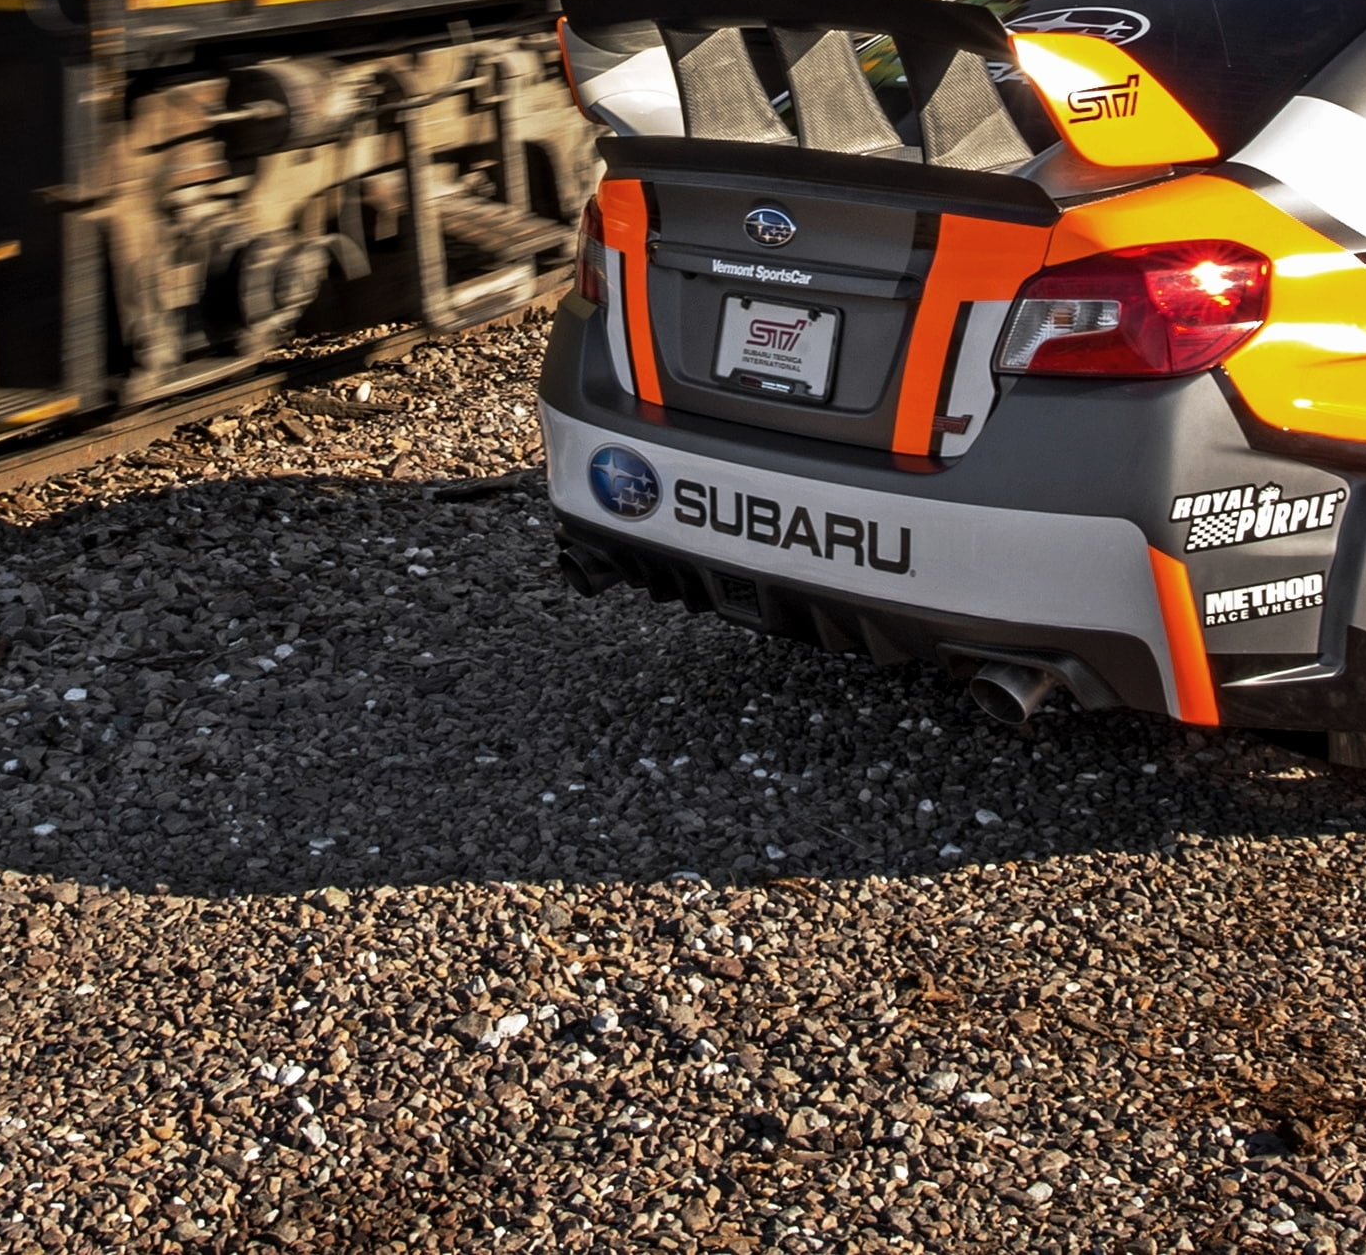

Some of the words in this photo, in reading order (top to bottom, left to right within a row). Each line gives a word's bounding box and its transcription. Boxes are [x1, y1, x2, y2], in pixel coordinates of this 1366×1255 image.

[712, 259, 754, 278] Vermont
[755, 265, 812, 285] SportsCar
[741, 356, 802, 373] INTERNATIONAL
[742, 348, 772, 359] SUBARU
[773, 353, 803, 365] TECNICA
[1171, 486, 1255, 520] ROYAL
[1234, 493, 1339, 543] PURPLE
[674, 478, 912, 576] SUBARU
[1205, 573, 1324, 615] METHOD
[1206, 609, 1250, 625] RACE
[1257, 594, 1324, 616] WHEELS
